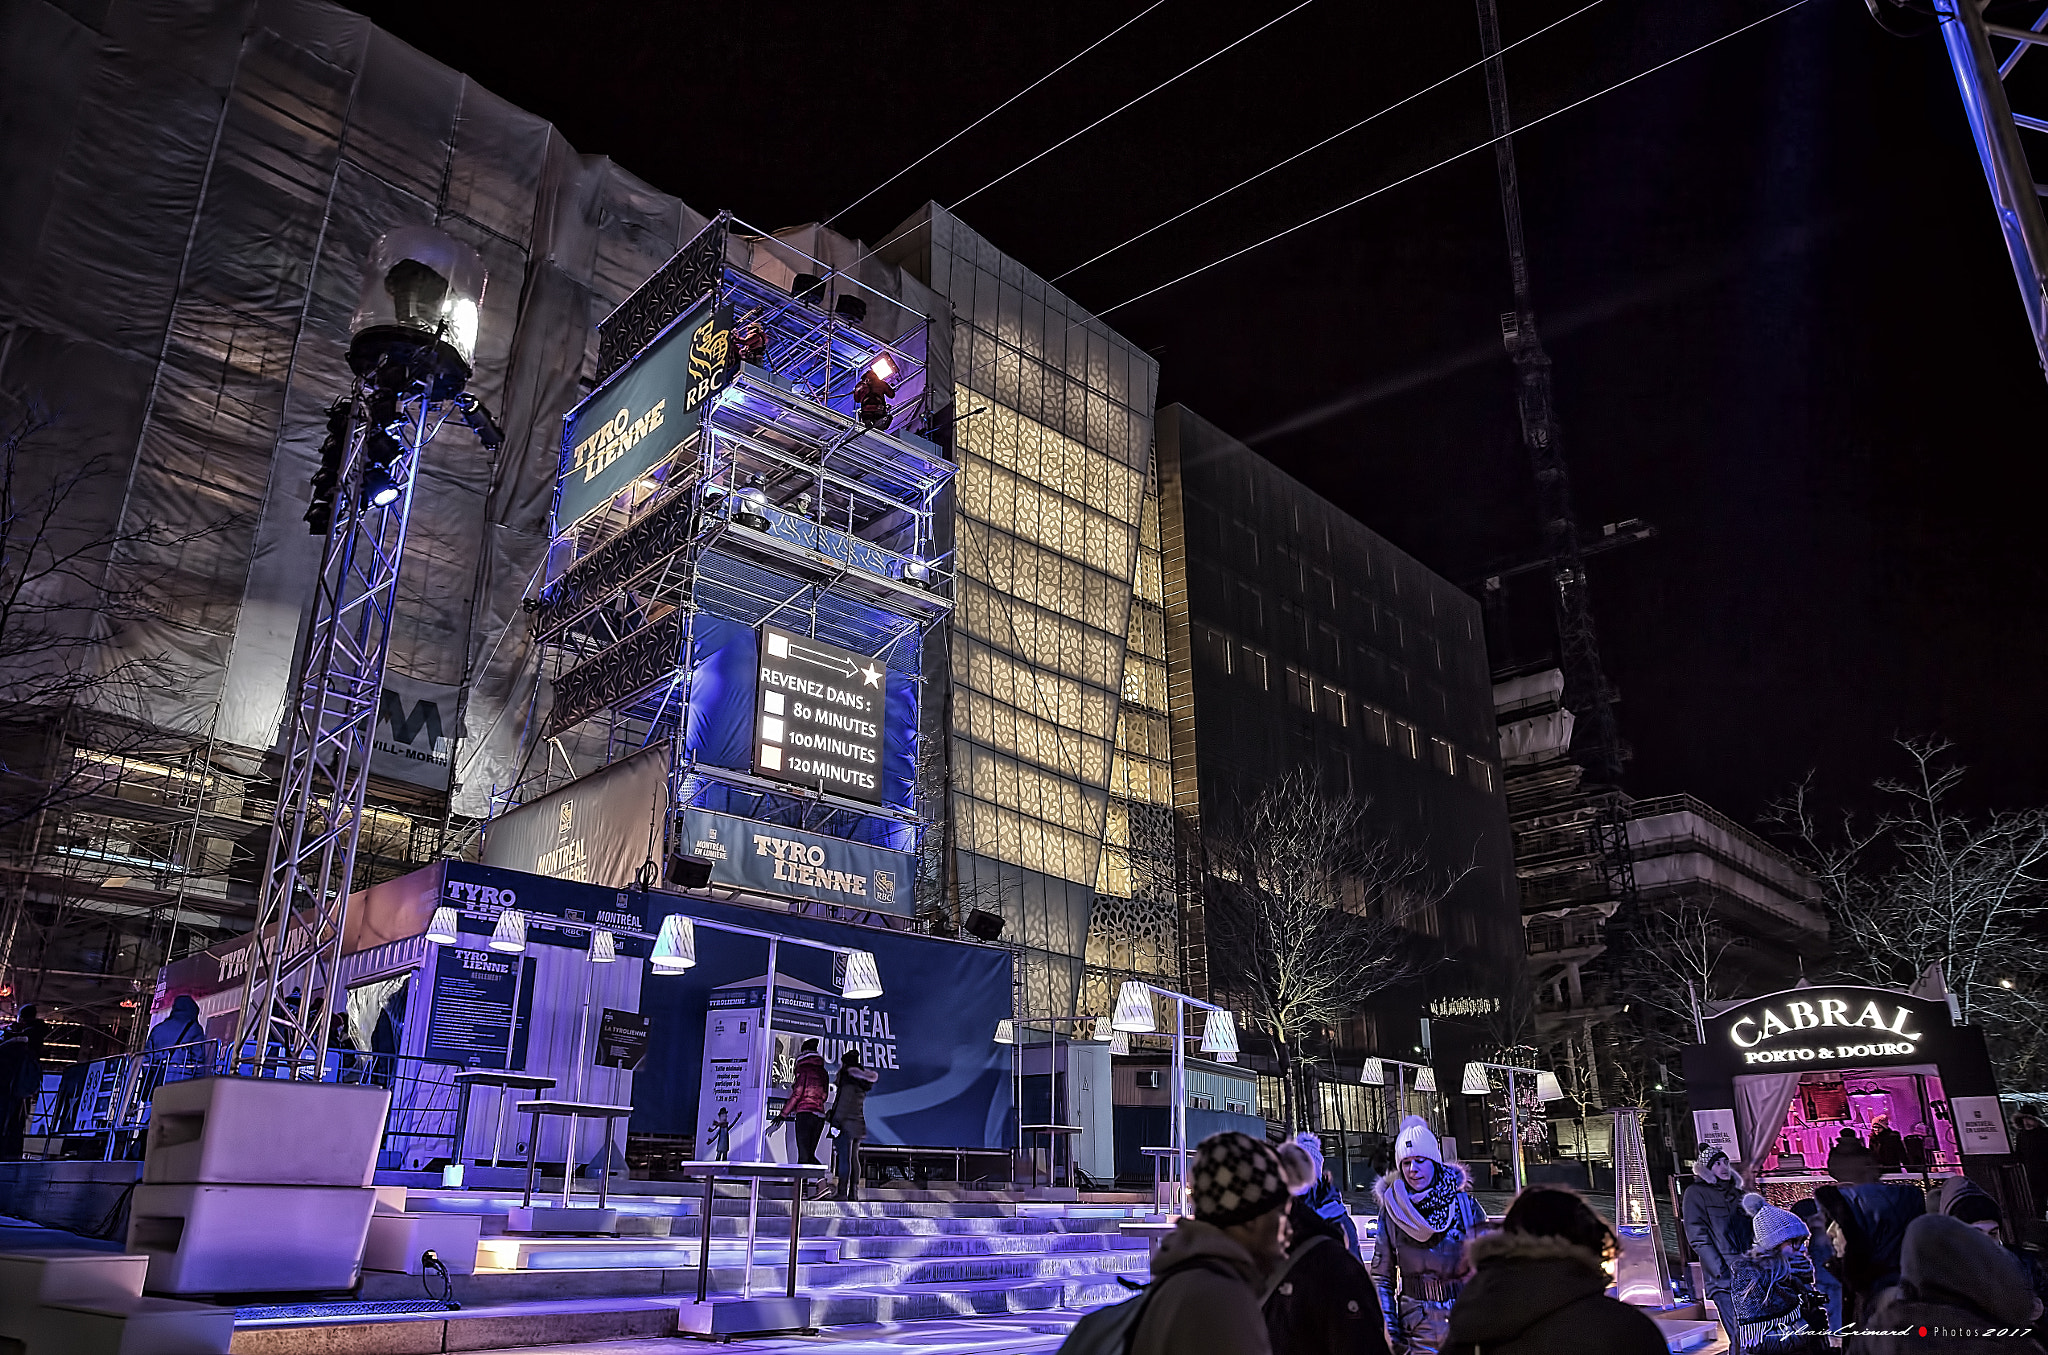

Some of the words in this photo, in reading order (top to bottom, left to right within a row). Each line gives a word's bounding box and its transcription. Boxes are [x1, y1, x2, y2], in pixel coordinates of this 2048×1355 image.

[685, 379, 723, 411] RBC
[574, 408, 629, 469] TYRO
[583, 399, 666, 484] LIENNE
[760, 667, 824, 698] REVENEZ
[793, 702, 812, 720] 80
[814, 708, 877, 738] MINUTES
[788, 731, 813, 748] 100
[813, 735, 876, 763] MINUTES
[788, 757, 811, 773] 120
[812, 760, 875, 789] MINUTES
[537, 839, 587, 875] MONTRÉAL
[753, 834, 825, 867] TYRO
[448, 880, 516, 907] TYRO
[773, 859, 867, 896] LIENNE
[876, 891, 892, 902] RBC
[597, 910, 642, 927] MONTRÉAL
[455, 949, 489, 962] TYRO
[463, 960, 509, 973] LIENNE
[613, 1026, 647, 1037] TYROLIENNE
[1729, 998, 1923, 1048] CABRAL
[1744, 1048, 1815, 1064] PORTO
[1818, 1047, 1835, 1060] &
[1836, 1042, 1915, 1058] DOURO
